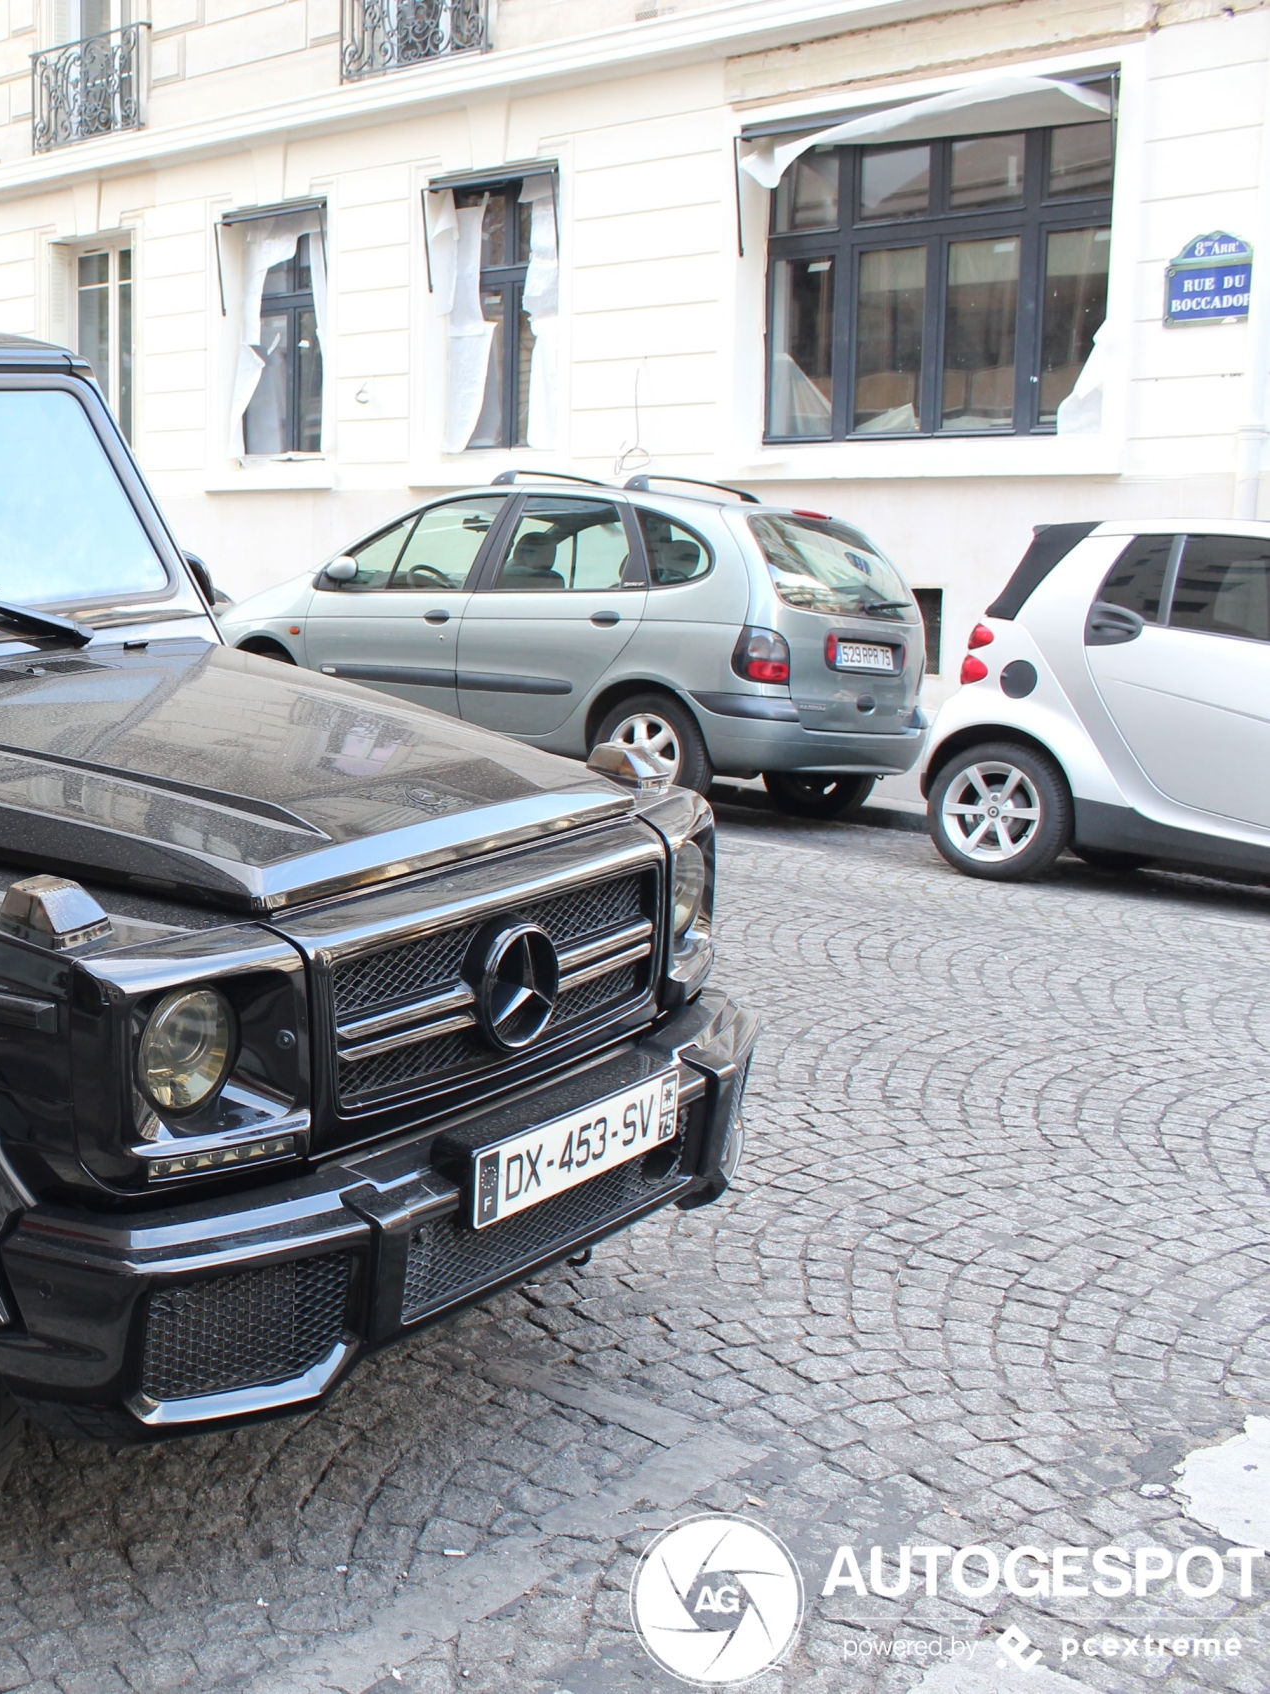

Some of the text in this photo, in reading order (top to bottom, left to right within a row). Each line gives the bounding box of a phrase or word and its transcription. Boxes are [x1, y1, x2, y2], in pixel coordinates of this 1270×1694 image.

[1183, 274, 1246, 293] RUE DU
[842, 645, 891, 666] 529 RPR 75
[660, 1112, 674, 1138] 75
[505, 1094, 655, 1202] DX-453-SV
[483, 1196, 493, 1212] F
